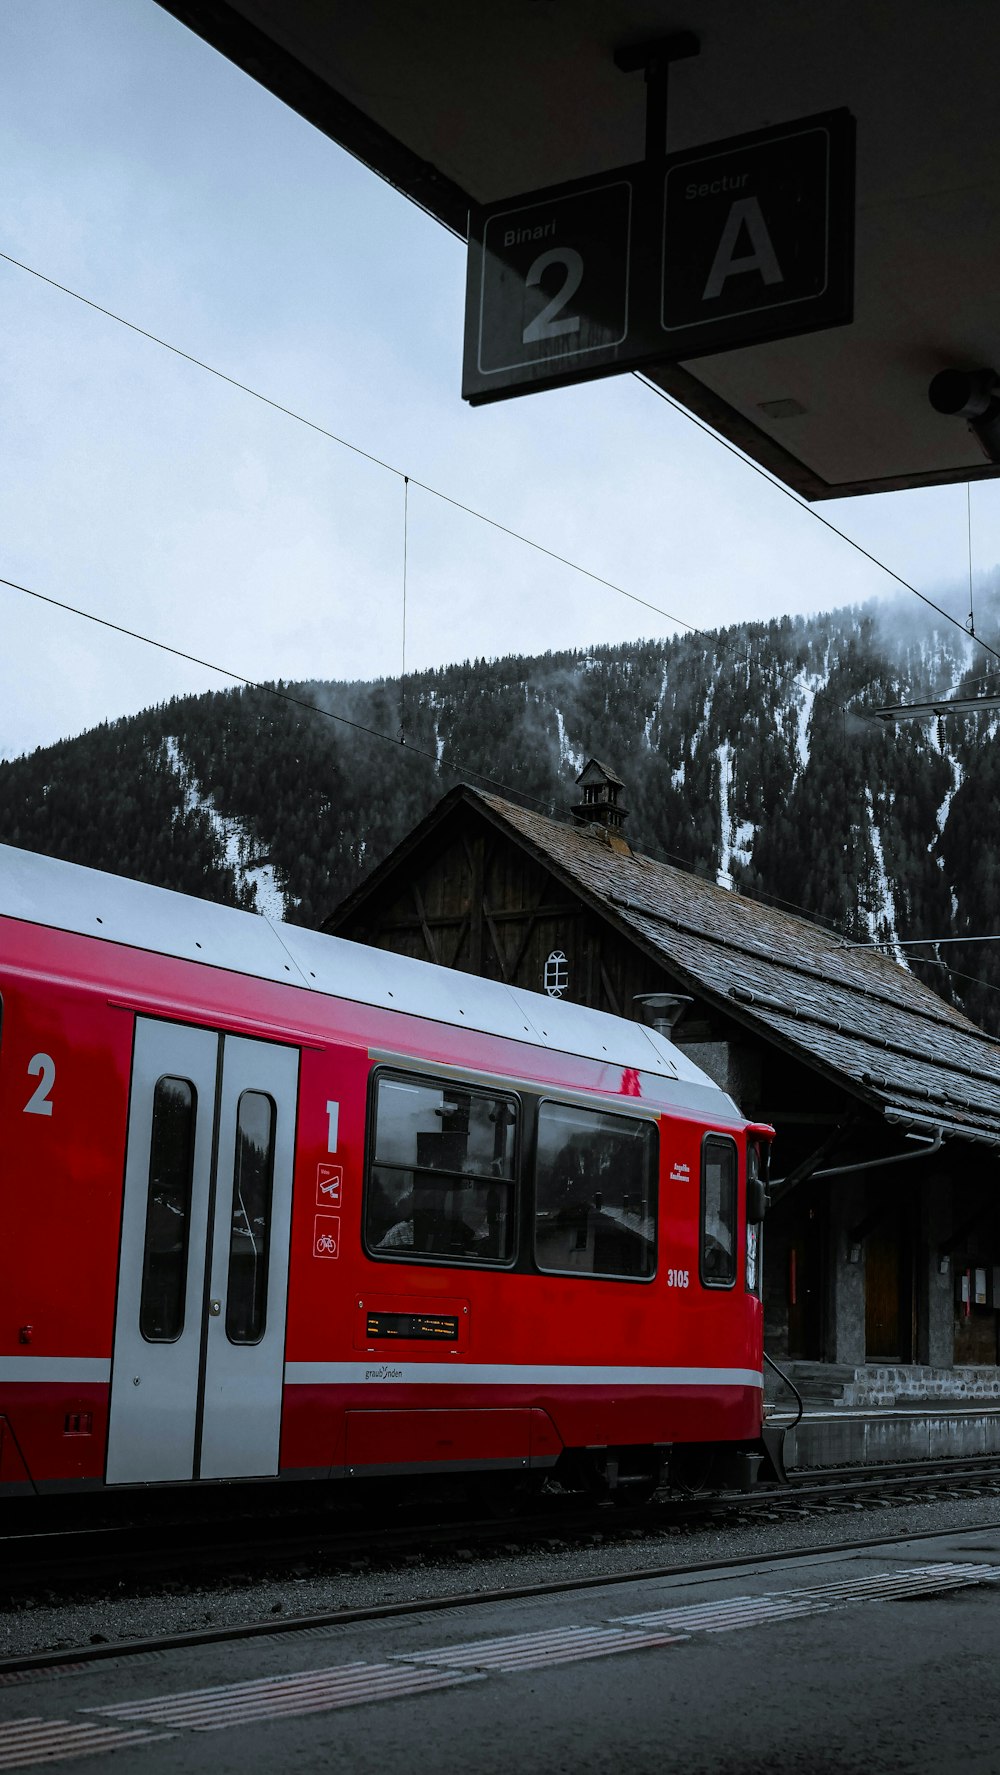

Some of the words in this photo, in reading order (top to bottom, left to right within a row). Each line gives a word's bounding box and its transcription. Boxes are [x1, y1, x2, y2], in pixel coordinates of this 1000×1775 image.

[685, 173, 749, 200] Sectur
[503, 218, 556, 248] Binari
[702, 196, 785, 301] A
[522, 246, 584, 345] 2
[23, 1052, 56, 1116] 2
[326, 1100, 340, 1154] 1
[667, 1268, 689, 1288] 3105
